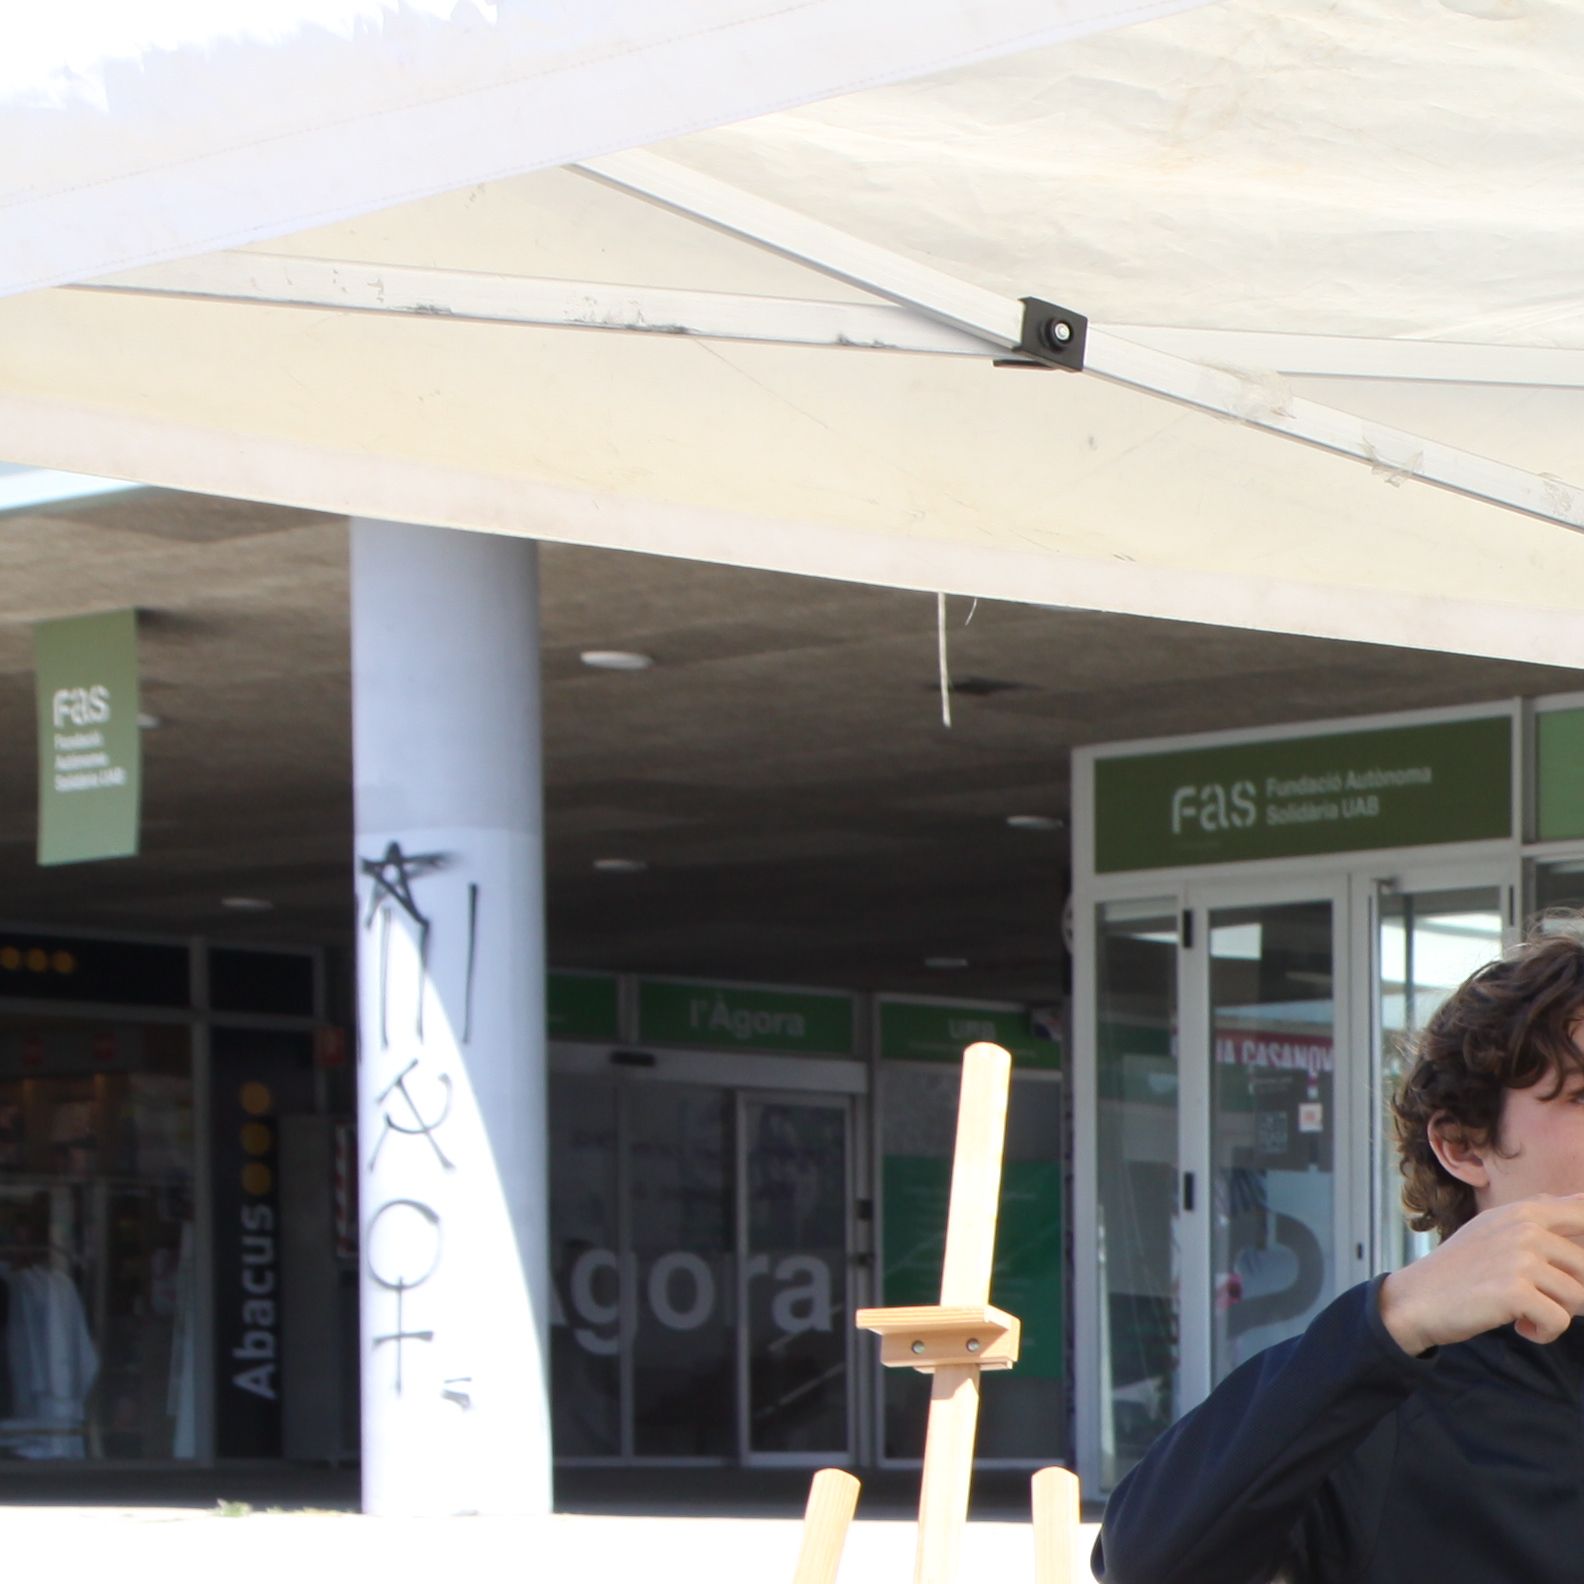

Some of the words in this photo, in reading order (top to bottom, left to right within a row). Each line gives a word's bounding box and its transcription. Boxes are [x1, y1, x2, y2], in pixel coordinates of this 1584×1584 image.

[1341, 795, 1380, 819] UAB
[1242, 1039, 1334, 1073] CASANOV
[232, 1202, 276, 1400] Abacus
[550, 1248, 833, 1356] gora
